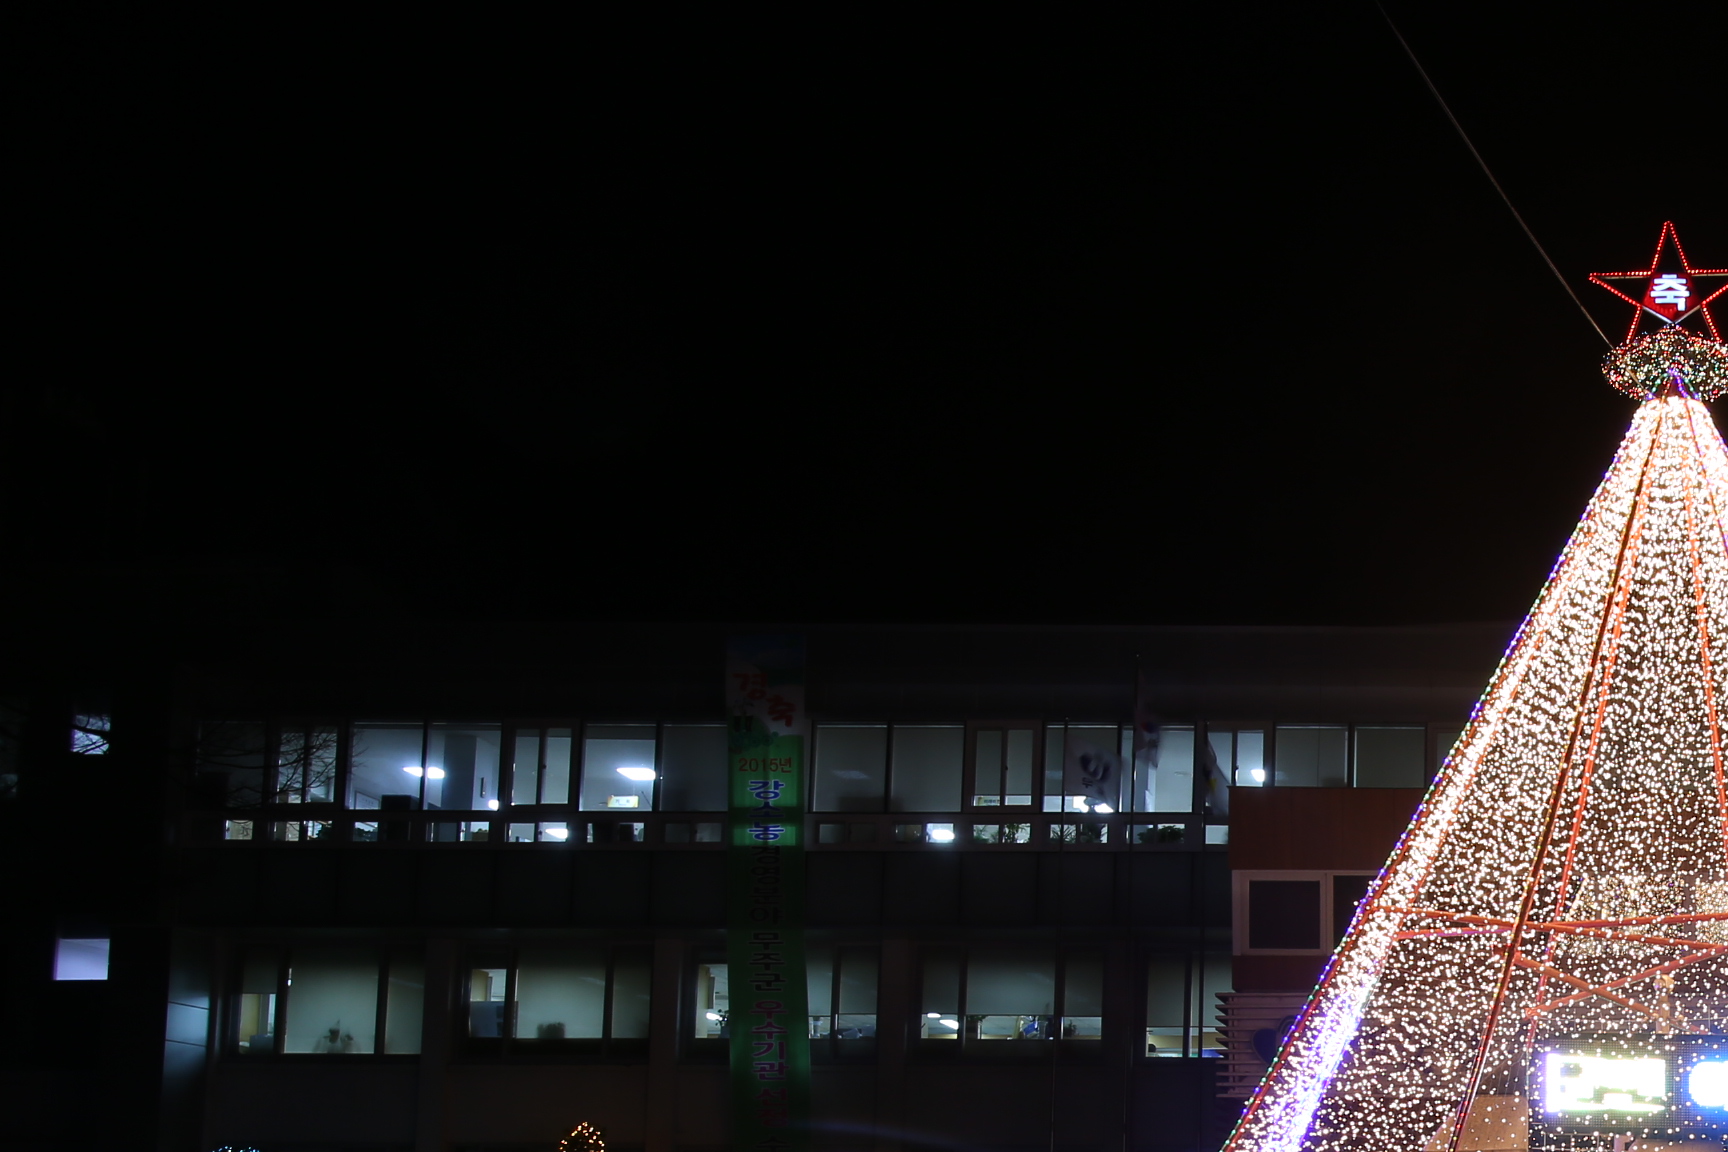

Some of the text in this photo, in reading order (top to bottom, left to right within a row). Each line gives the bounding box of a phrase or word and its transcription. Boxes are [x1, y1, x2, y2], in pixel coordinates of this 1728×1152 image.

[1650, 274, 1690, 311] 축
[732, 672, 797, 727] 경축
[738, 757, 793, 773] 2015년
[748, 779, 785, 841] 강소농
[748, 931, 787, 992] 무주군
[749, 1000, 790, 1081] 우수기관
[753, 1087, 790, 1128] 선정
